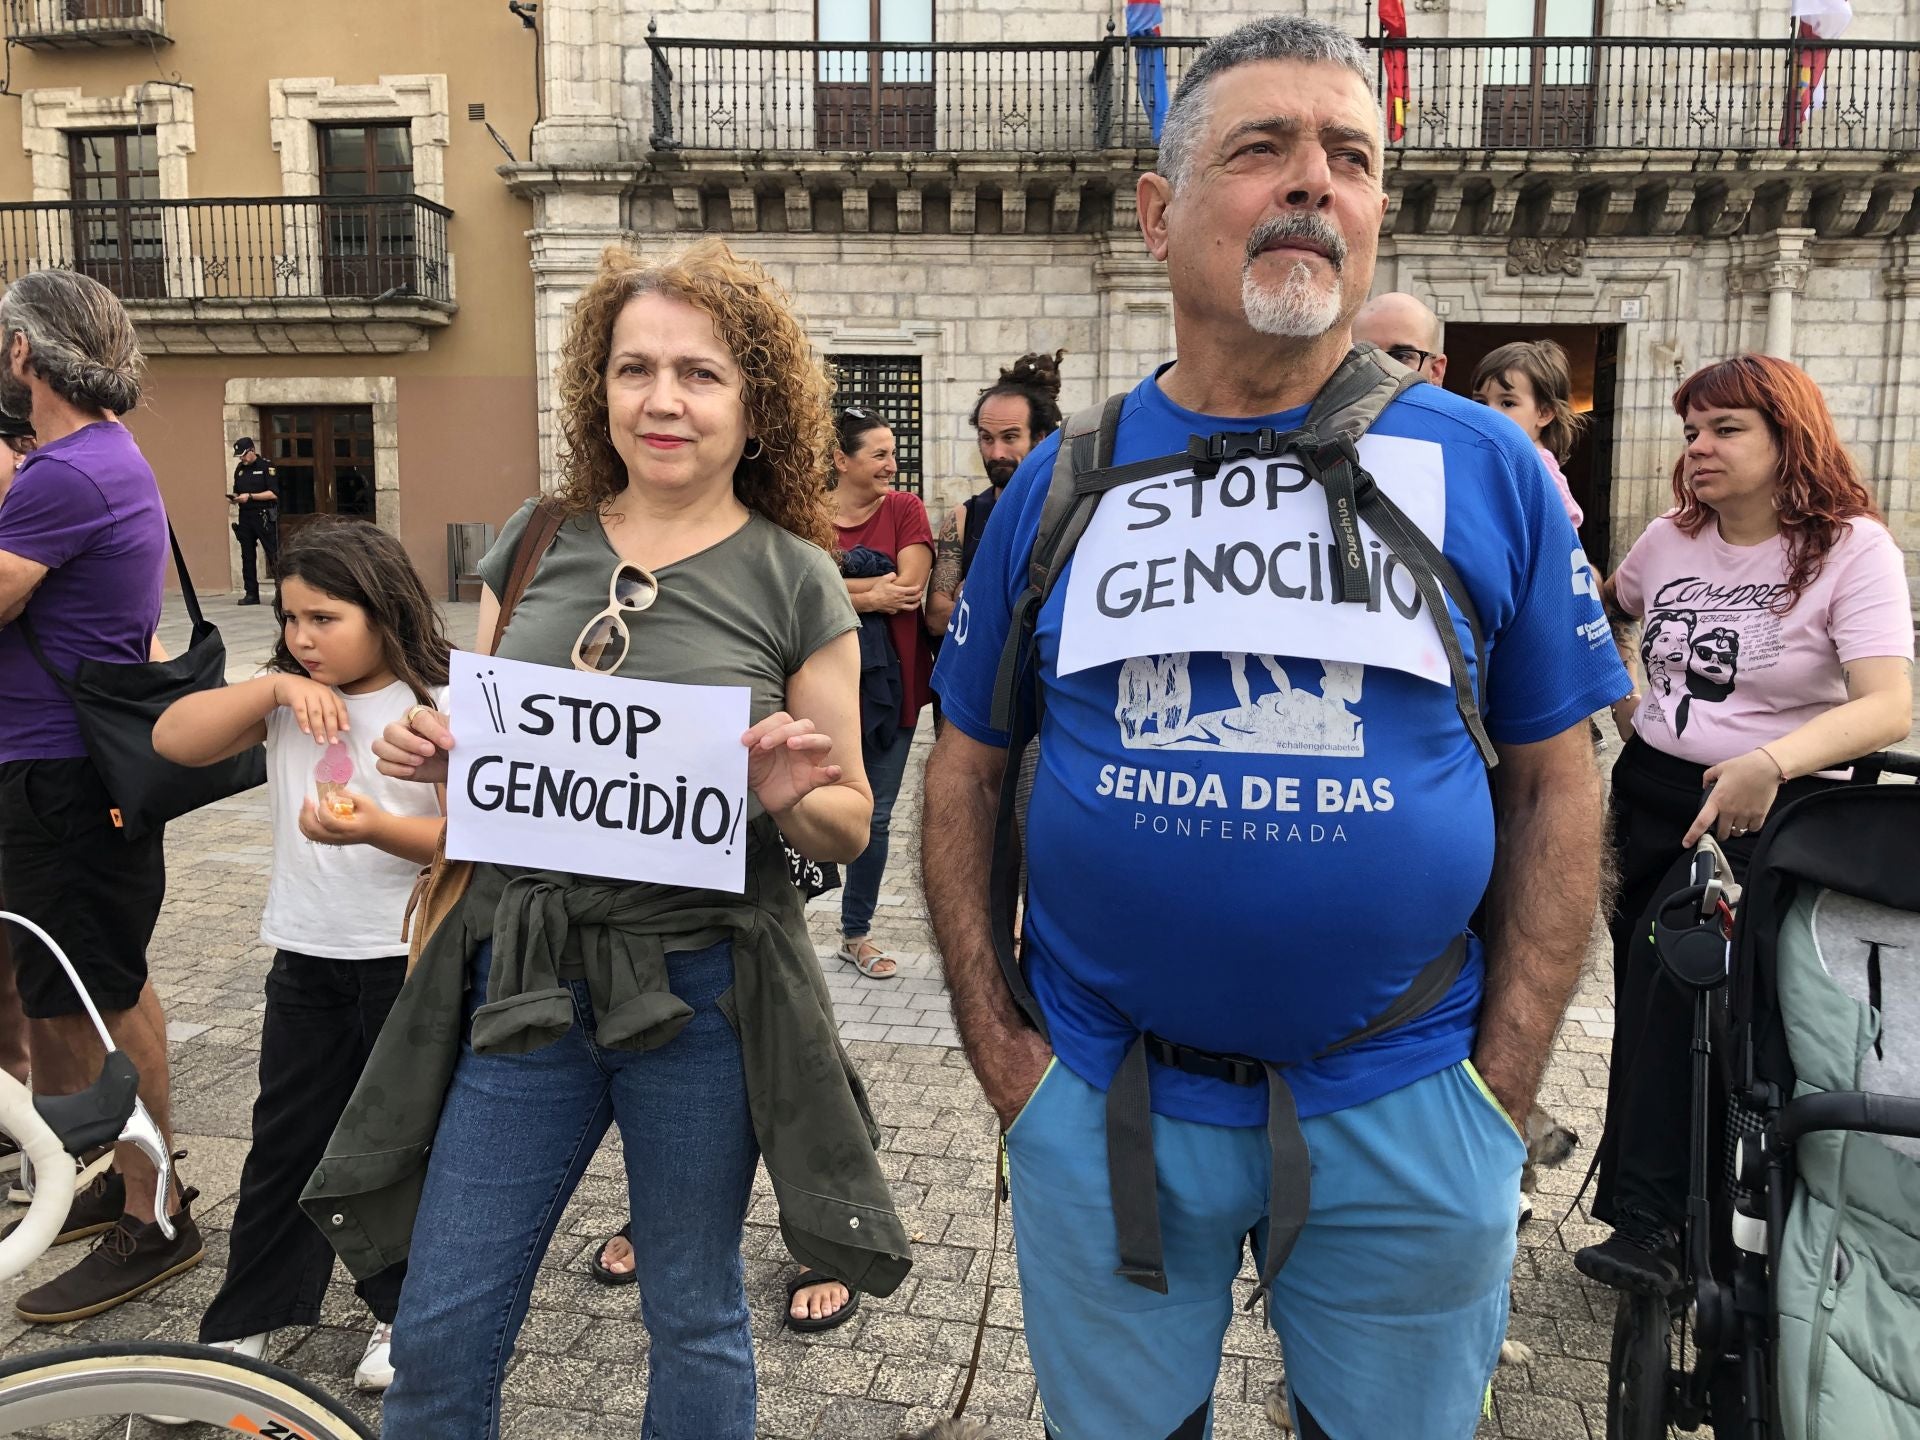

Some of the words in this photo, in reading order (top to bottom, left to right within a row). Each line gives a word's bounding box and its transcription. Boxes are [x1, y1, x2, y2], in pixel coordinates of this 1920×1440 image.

[1127, 462, 1311, 531] STOP
[1338, 497, 1361, 569] Quechua
[1276, 740, 1360, 752] #challengediabetes
[1095, 763, 1228, 808] SENDA
[1241, 775, 1301, 812] DE
[1316, 777, 1395, 813] BAS
[1134, 812, 1347, 842] PONFERRADA
